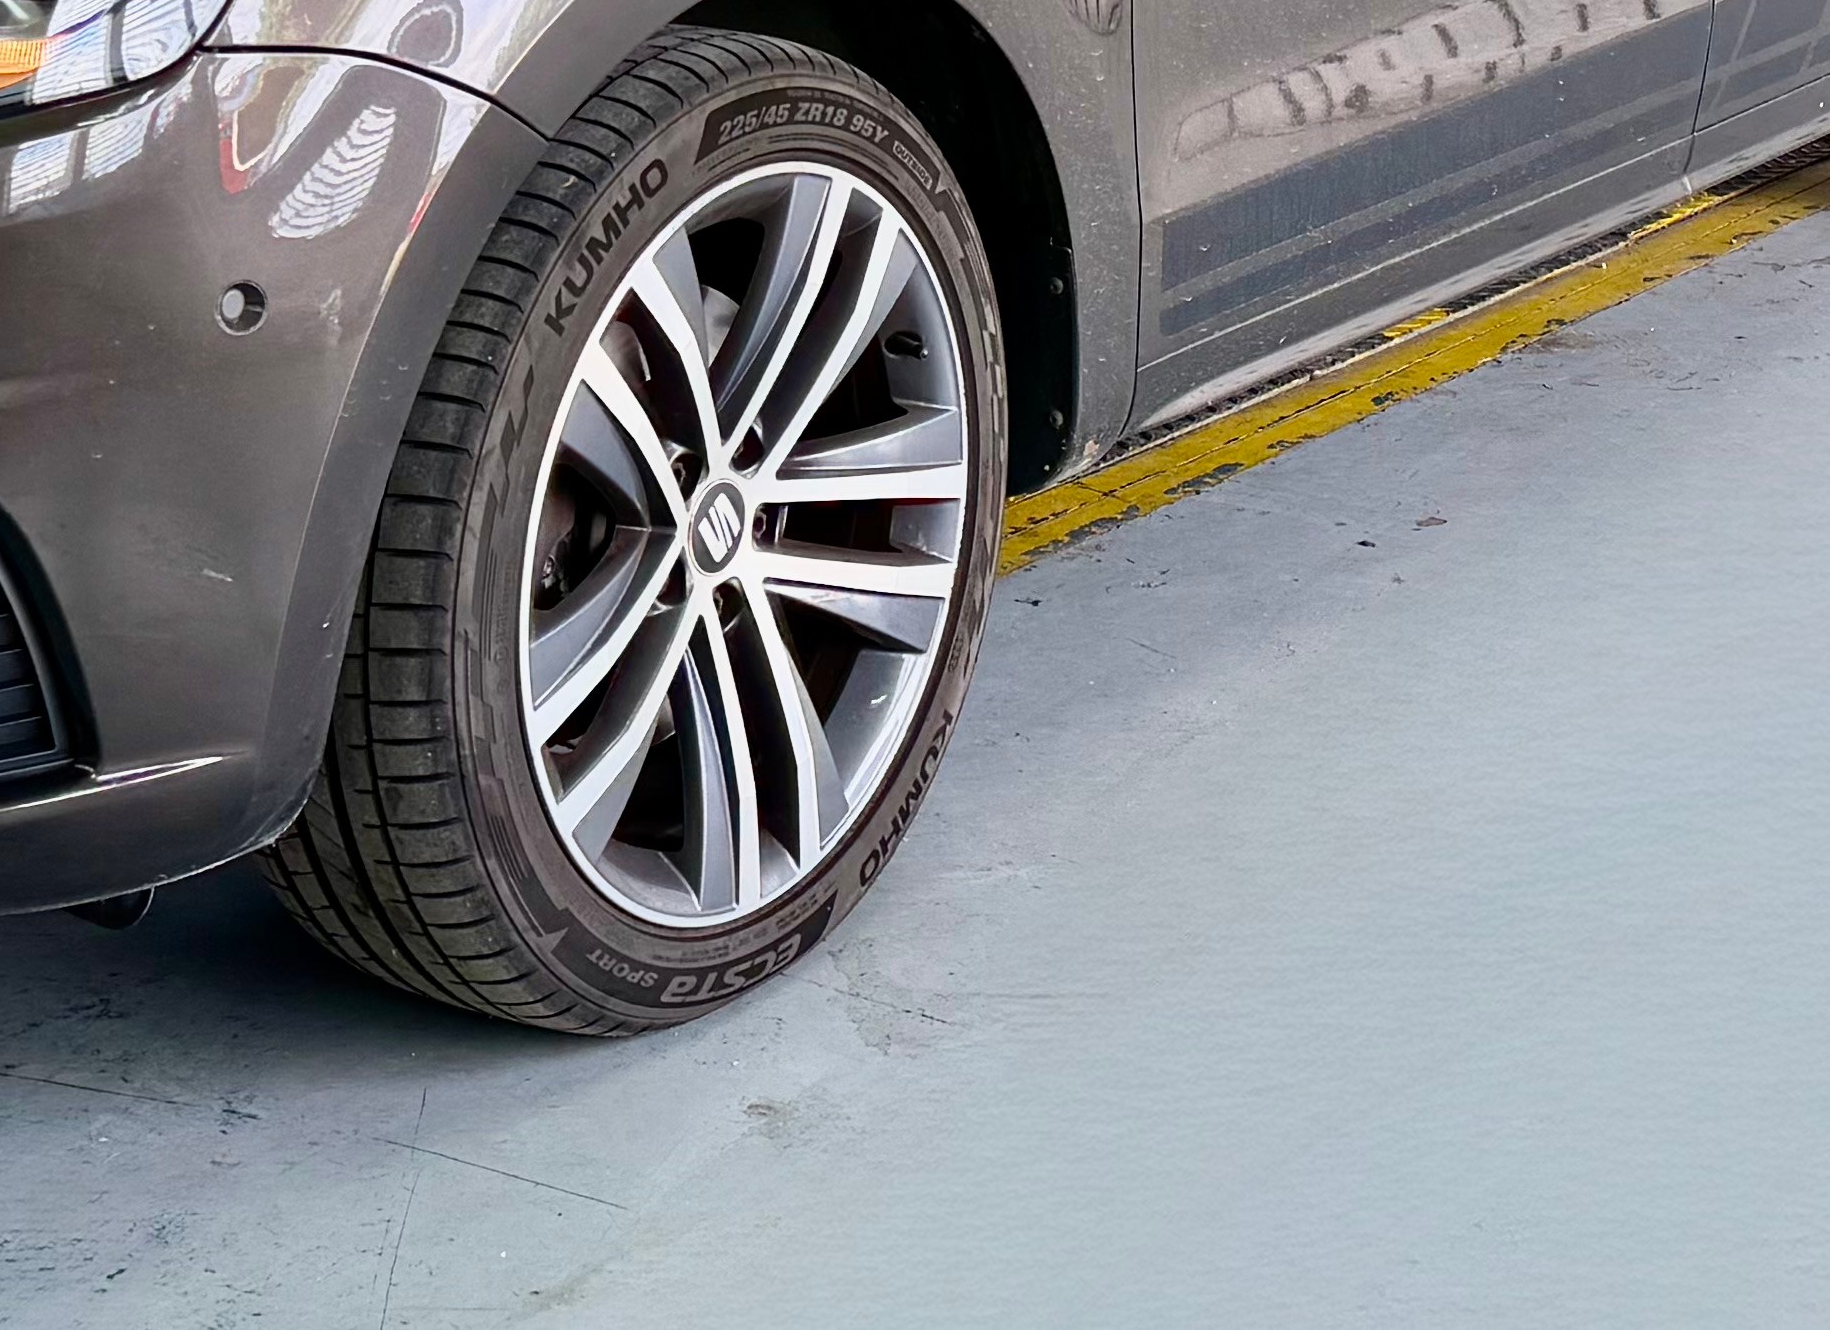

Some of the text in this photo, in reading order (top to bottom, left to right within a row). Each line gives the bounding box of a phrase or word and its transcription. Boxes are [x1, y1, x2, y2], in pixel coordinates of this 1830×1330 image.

[718, 103, 791, 145] 225/45
[793, 101, 848, 127] ZR18
[849, 113, 890, 144] 95Y
[544, 158, 669, 338] KUMHO
[858, 708, 955, 888] KUMHO
[586, 948, 660, 988] SPORT
